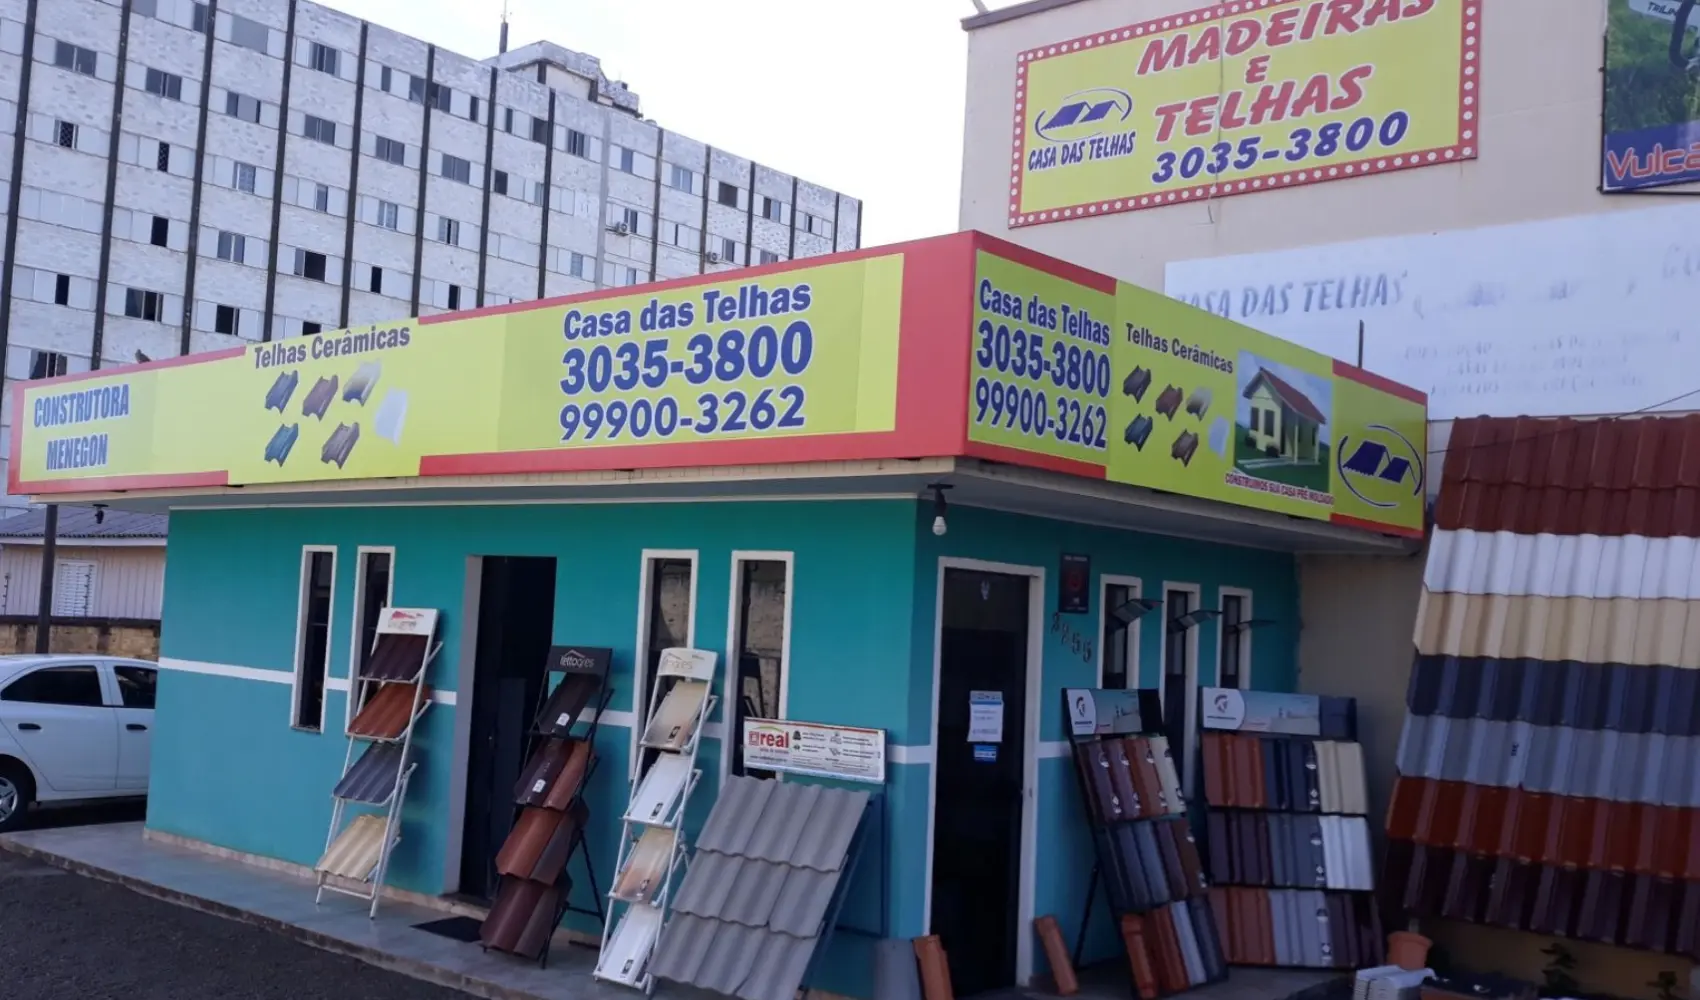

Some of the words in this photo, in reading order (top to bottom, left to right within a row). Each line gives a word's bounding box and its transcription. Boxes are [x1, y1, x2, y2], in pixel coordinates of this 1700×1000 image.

[1245, 55, 1271, 84] E
[1154, 65, 1372, 142] TELHAS
[1028, 148, 1057, 171] CASA
[1061, 141, 1085, 165] DAS
[1089, 131, 1136, 160] TELHAS
[1151, 111, 1409, 183] 3035-3800
[564, 309, 631, 341] Casa
[640, 299, 694, 332] das
[703, 283, 811, 324] Telhas
[980, 279, 1022, 320] Casa
[1027, 295, 1057, 330] das
[1061, 304, 1110, 346] Telhas
[1241, 281, 1294, 317] DAS
[254, 343, 307, 369] Telhas
[312, 325, 410, 360] Cerâmicas
[560, 321, 812, 395] 3035-3800
[976, 319, 1111, 398] 3035-3800
[1126, 322, 1168, 353] Telhas
[1171, 338, 1233, 374] Cerâmicas
[34, 384, 129, 428] CONSTRUTORA
[560, 386, 805, 441] 99900-3262
[975, 378, 1107, 449] 99900-3262
[46, 433, 108, 470] MENEGON
[760, 731, 790, 748] real
